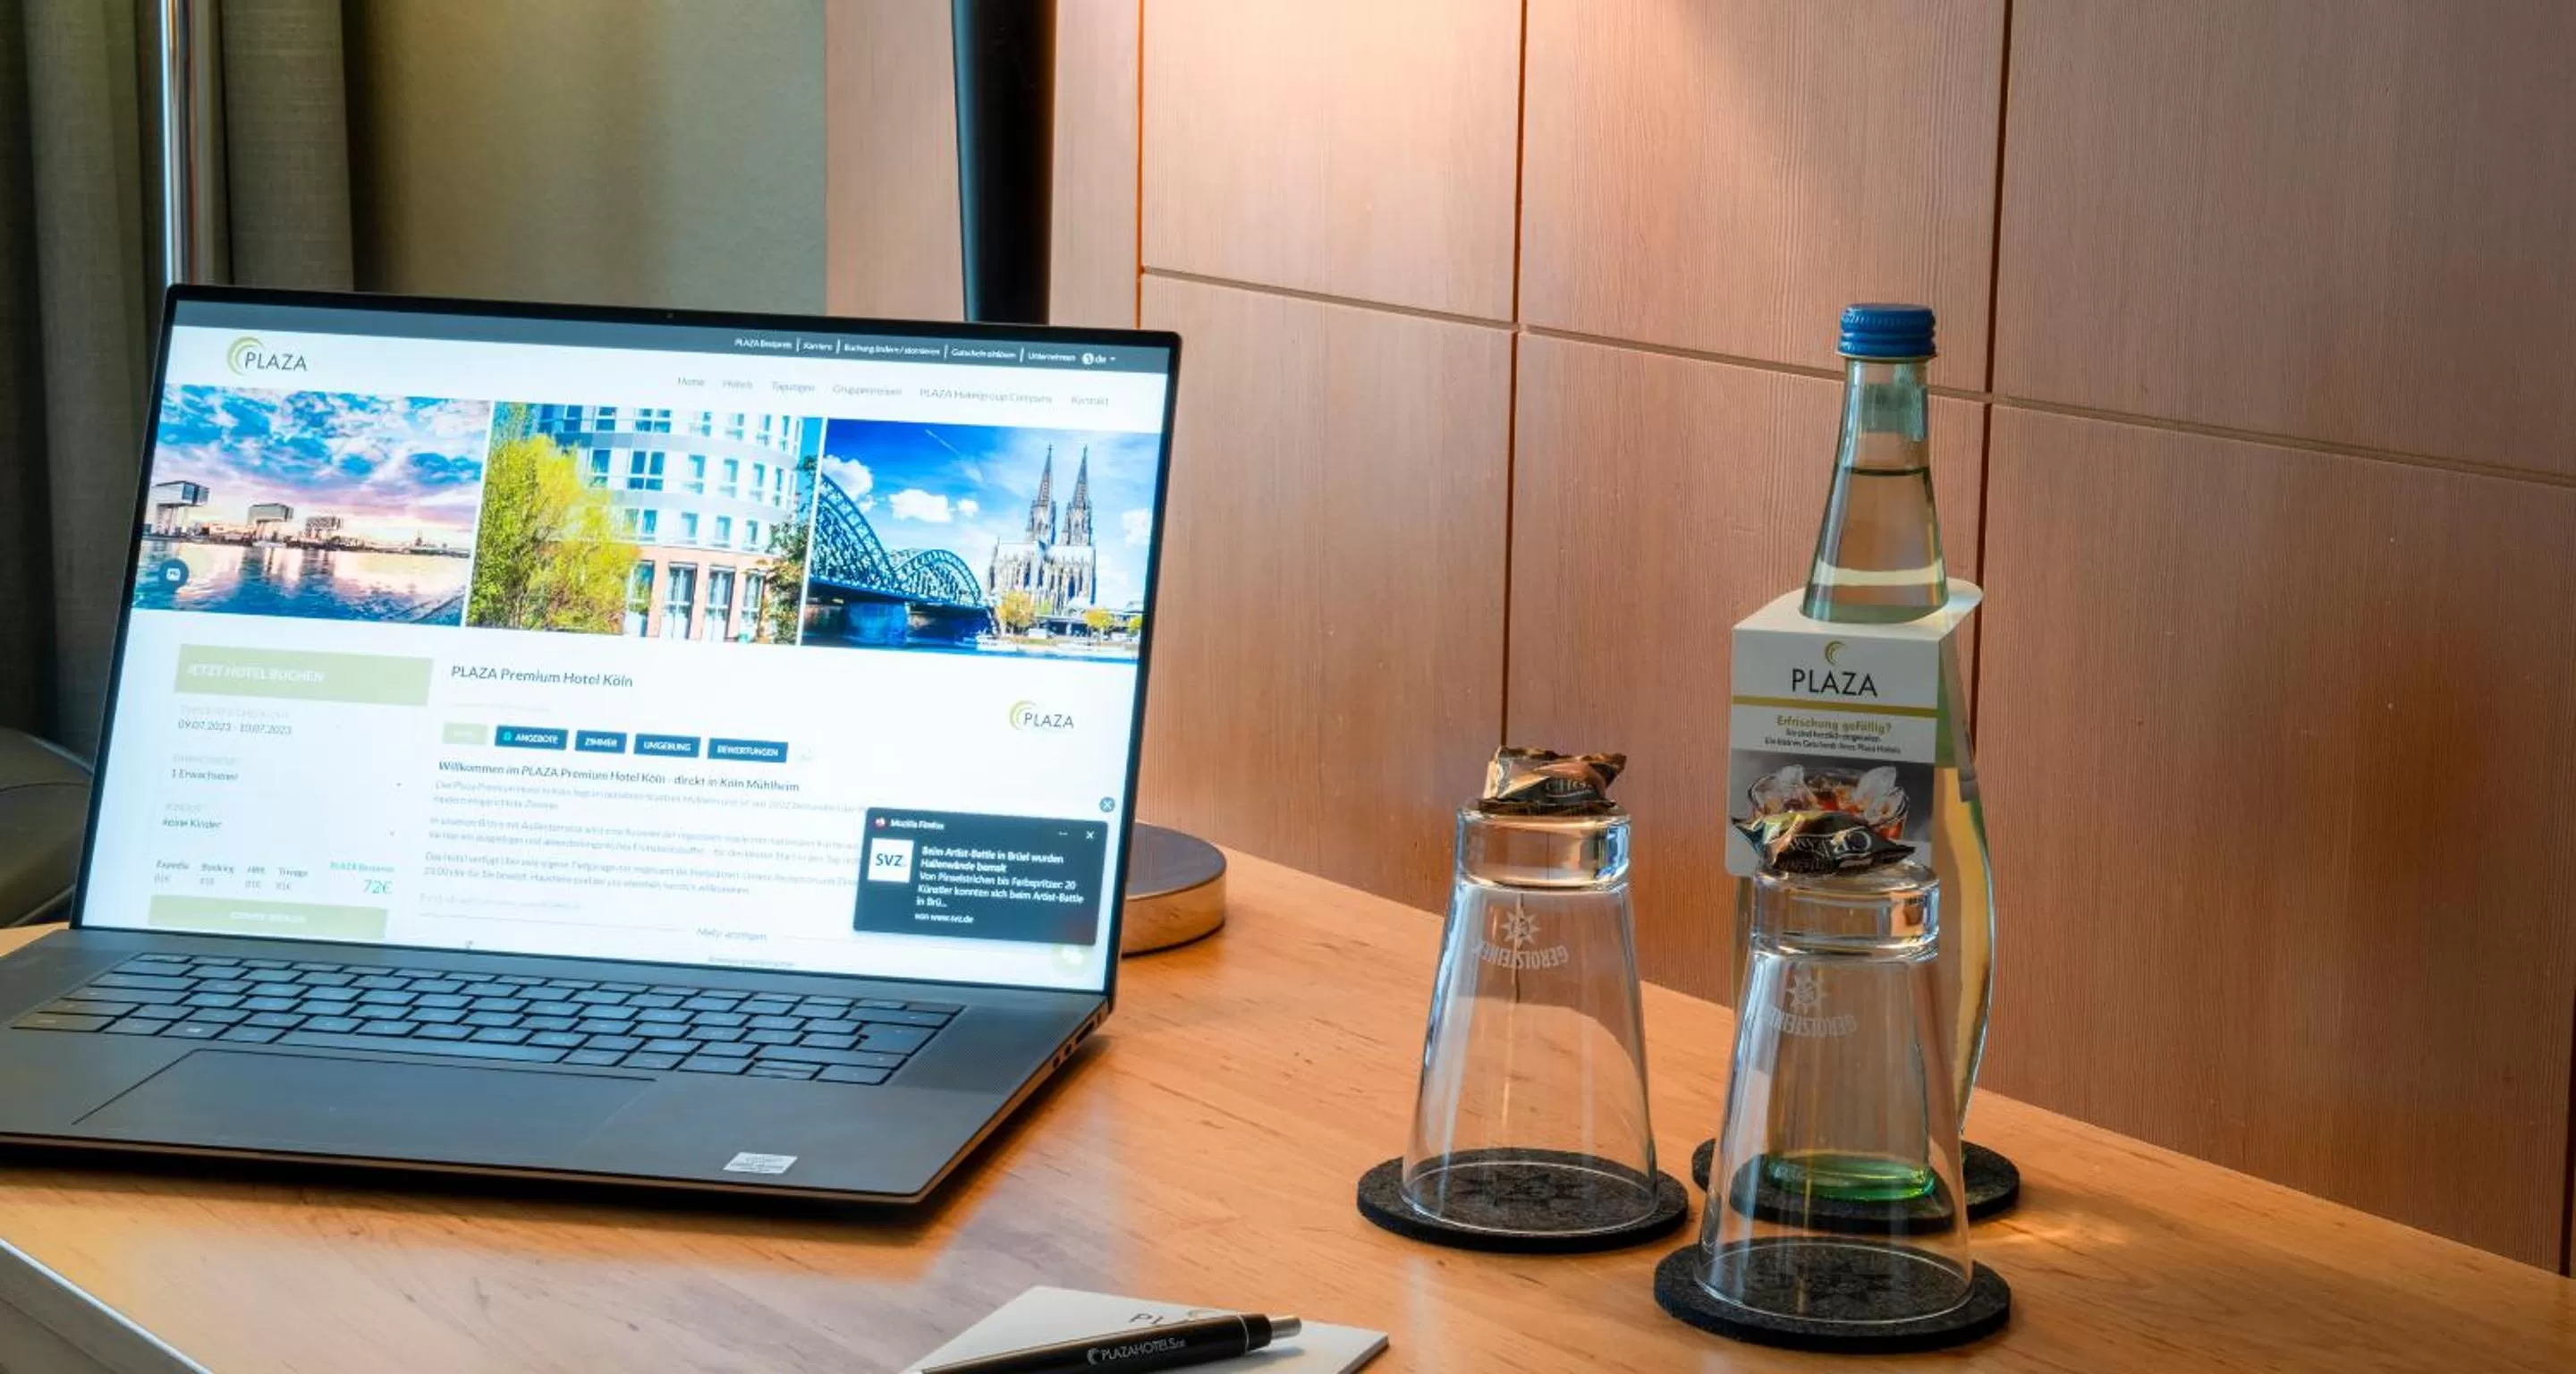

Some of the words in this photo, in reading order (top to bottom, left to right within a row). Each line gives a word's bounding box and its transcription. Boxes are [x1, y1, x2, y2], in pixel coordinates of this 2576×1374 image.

[245, 351, 307, 371] PLAZA
[451, 666, 497, 680] PLAZA
[500, 667, 561, 683] Premium
[564, 672, 600, 685] Hotel
[603, 673, 633, 688] Köln
[1792, 668, 1878, 698] PLAZA
[1024, 712, 1074, 729] PLAZA
[1776, 715, 1838, 731] Erfrischung
[1842, 719, 1892, 735] gefällig?
[514, 733, 558, 745] ANGEBOTE
[584, 736, 617, 748] ZIMMER
[643, 740, 691, 752] UMGEBUNG
[717, 743, 779, 757] BEWERTUNGEN
[438, 760, 504, 775] Willkommen
[506, 766, 520, 776] im
[521, 766, 559, 777] PLAZA
[561, 768, 608, 781] Premium
[610, 771, 640, 783] Hotel
[674, 775, 706, 787] direkt
[890, 818, 918, 828] Mozilla
[919, 820, 945, 830] Firefox
[921, 846, 944, 856] Beim
[945, 848, 996, 860] Artist-Battle
[997, 850, 1005, 860] in
[1031, 852, 1064, 864] wurden
[920, 859, 975, 870] Hallenwände
[977, 861, 1007, 872] bemalt
[362, 879, 394, 895] 72€
[919, 871, 936, 881] Von
[937, 872, 996, 885] Pinselstrichen
[997, 876, 1010, 886] bis
[1064, 880, 1076, 890] 20
[916, 896, 925, 905] in
[918, 884, 953, 895] Künstler
[954, 886, 989, 897] konnten
[990, 888, 1007, 898] sich
[1009, 890, 1031, 900] beim
[1032, 892, 1084, 904] Artist-Battle
